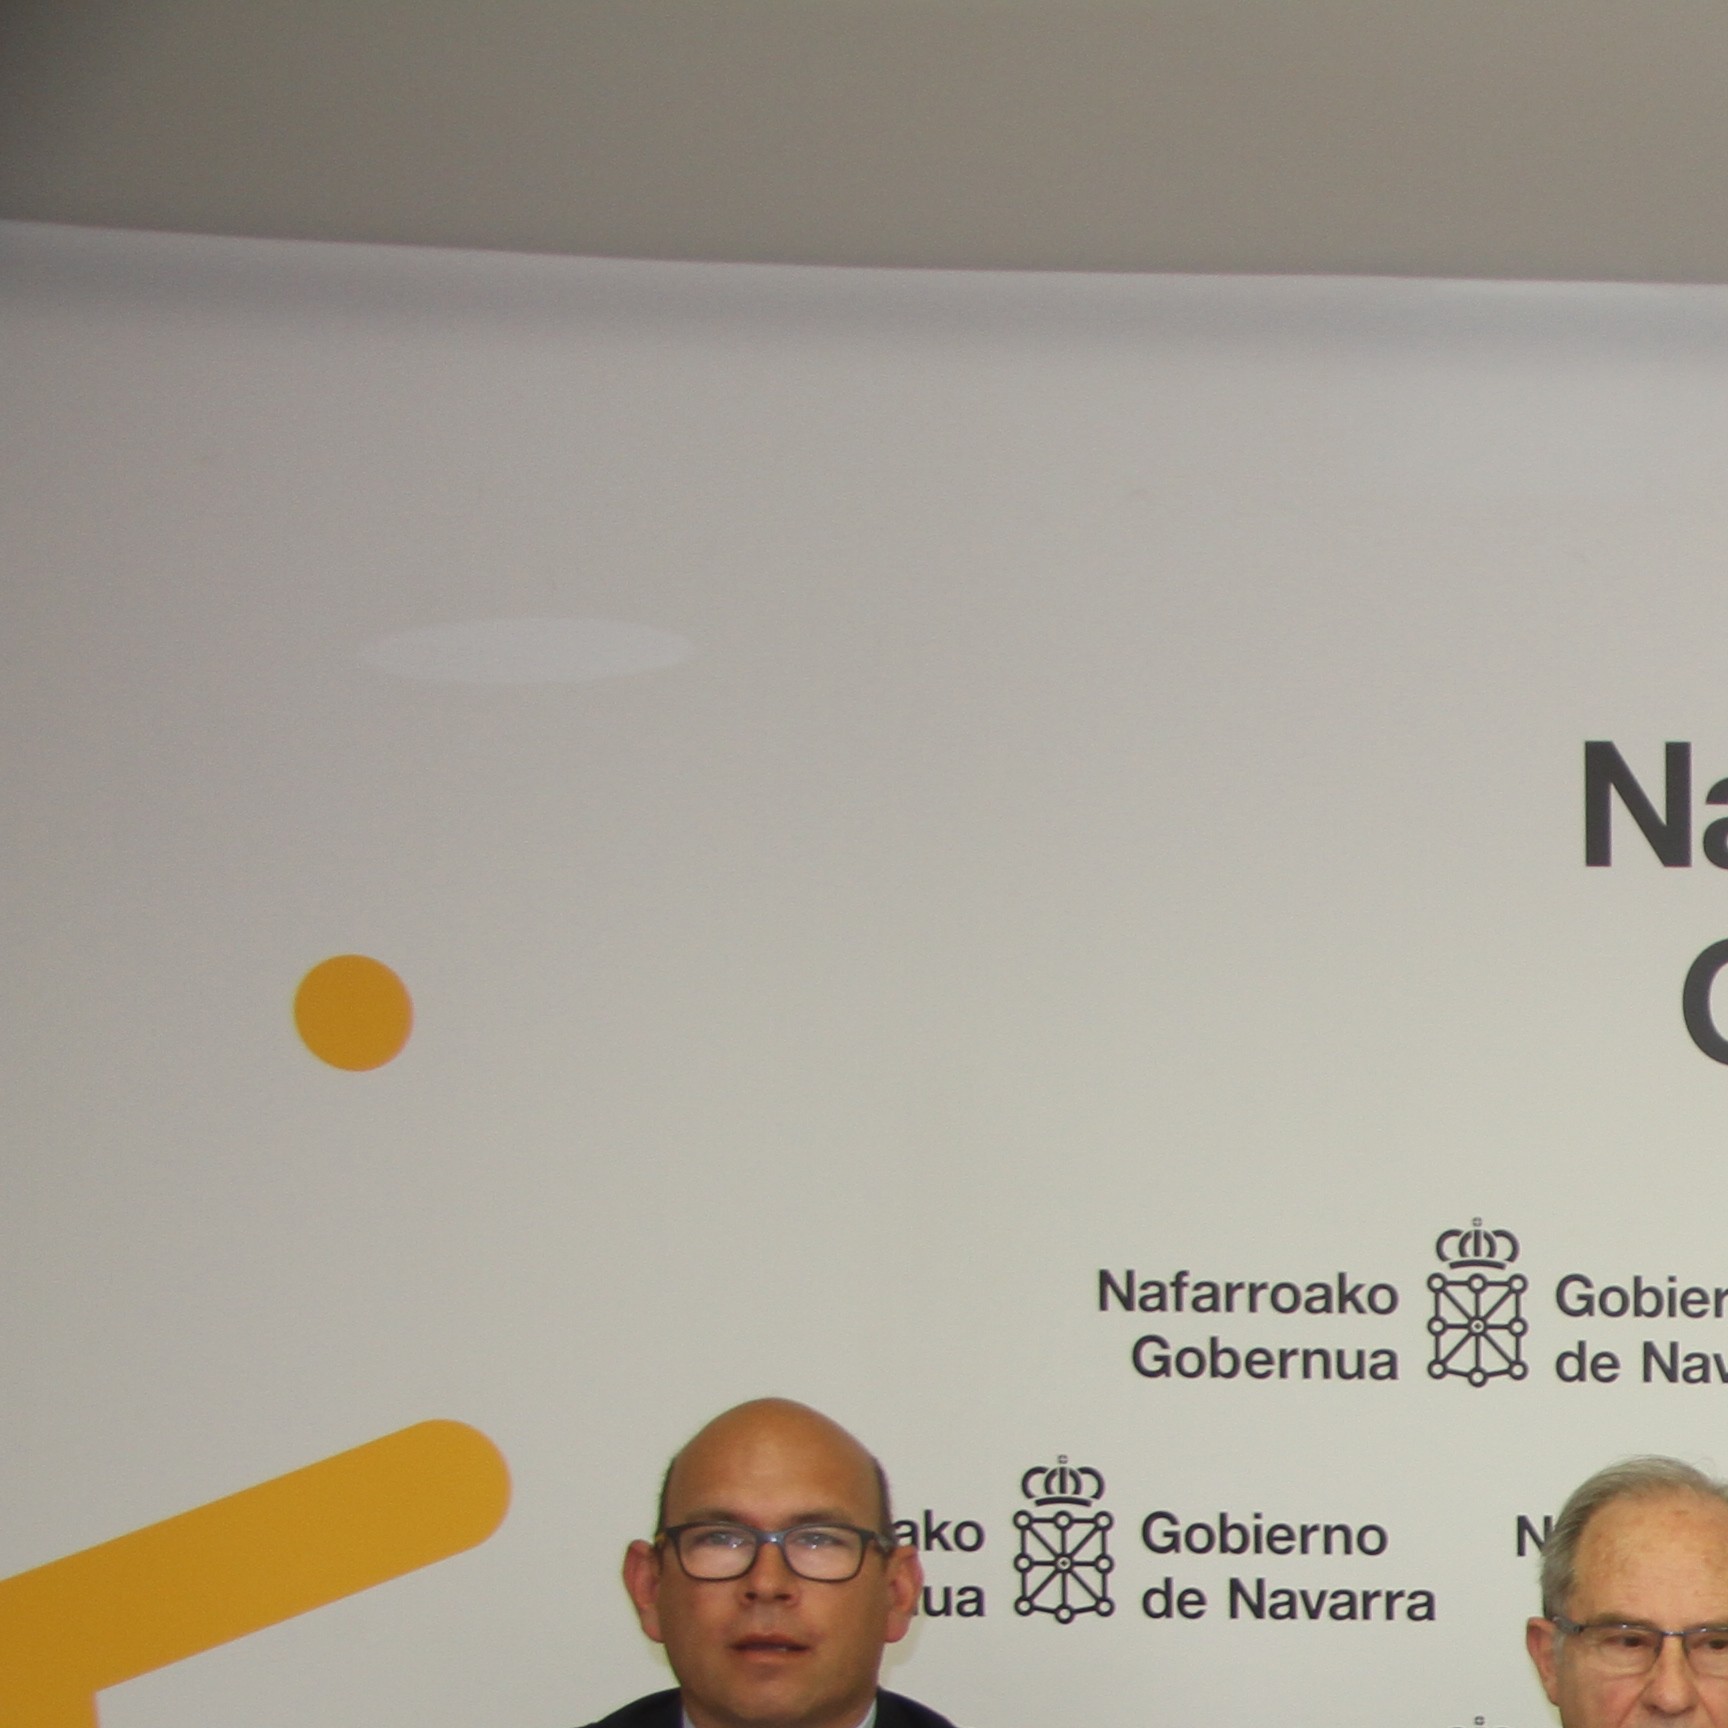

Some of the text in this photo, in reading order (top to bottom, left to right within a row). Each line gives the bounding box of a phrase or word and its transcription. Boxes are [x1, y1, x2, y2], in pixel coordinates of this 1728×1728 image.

[1098, 1268, 1398, 1315] Nafarroako
[1131, 1334, 1398, 1381] Gobernua
[1555, 1340, 1620, 1384] de
[1141, 1510, 1387, 1556] Gobierno
[1141, 1576, 1435, 1622] de Navarra
